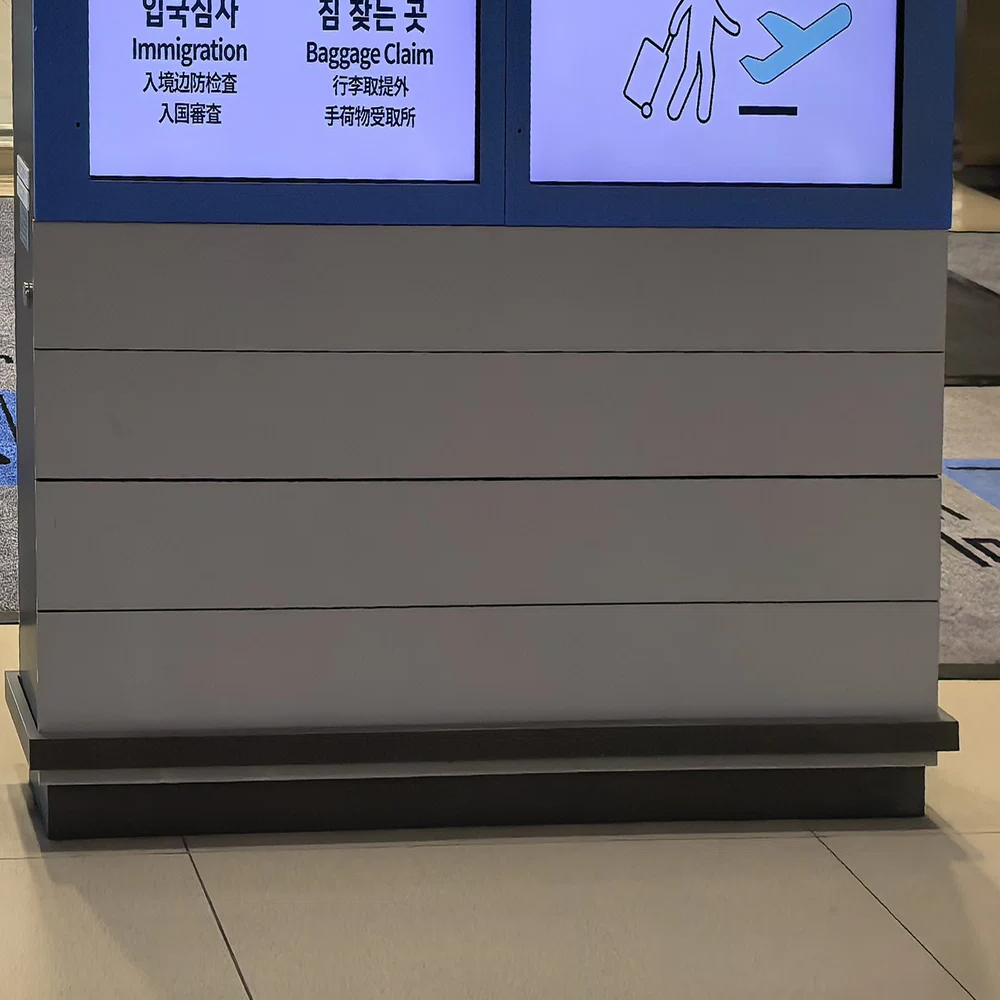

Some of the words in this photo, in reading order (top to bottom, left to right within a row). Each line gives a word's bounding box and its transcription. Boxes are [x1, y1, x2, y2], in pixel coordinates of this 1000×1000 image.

[404, 0, 428, 34] 곳
[132, 37, 248, 67] Immigration
[306, 41, 381, 70] Baggage
[384, 42, 434, 66] Claim
[332, 75, 409, 98] 行李取提外
[324, 105, 416, 128] 手荷物受取所
